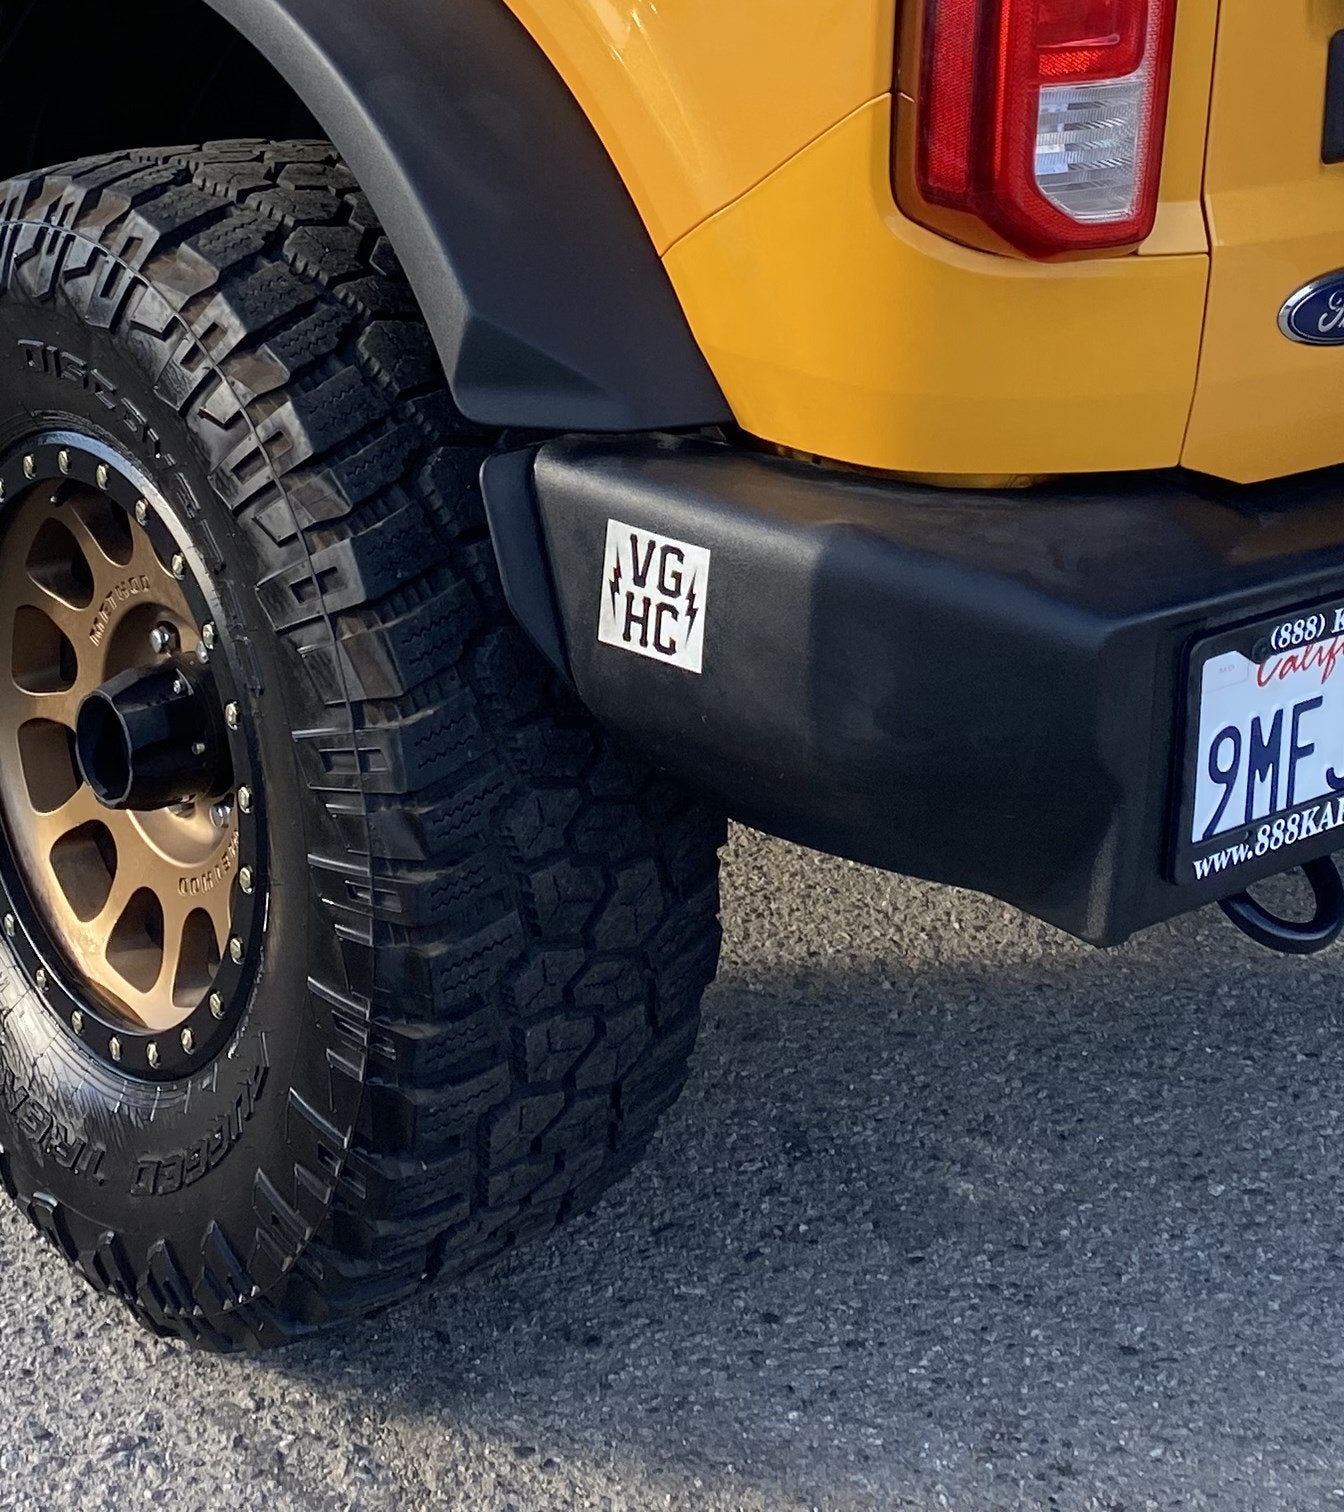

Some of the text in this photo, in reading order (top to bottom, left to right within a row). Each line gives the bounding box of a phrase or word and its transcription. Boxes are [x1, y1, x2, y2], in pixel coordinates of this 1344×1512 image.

[629, 533, 685, 599] VG
[89, 574, 151, 648] METHOD
[622, 590, 680, 656] HC
[1270, 613, 1326, 651] (888)
